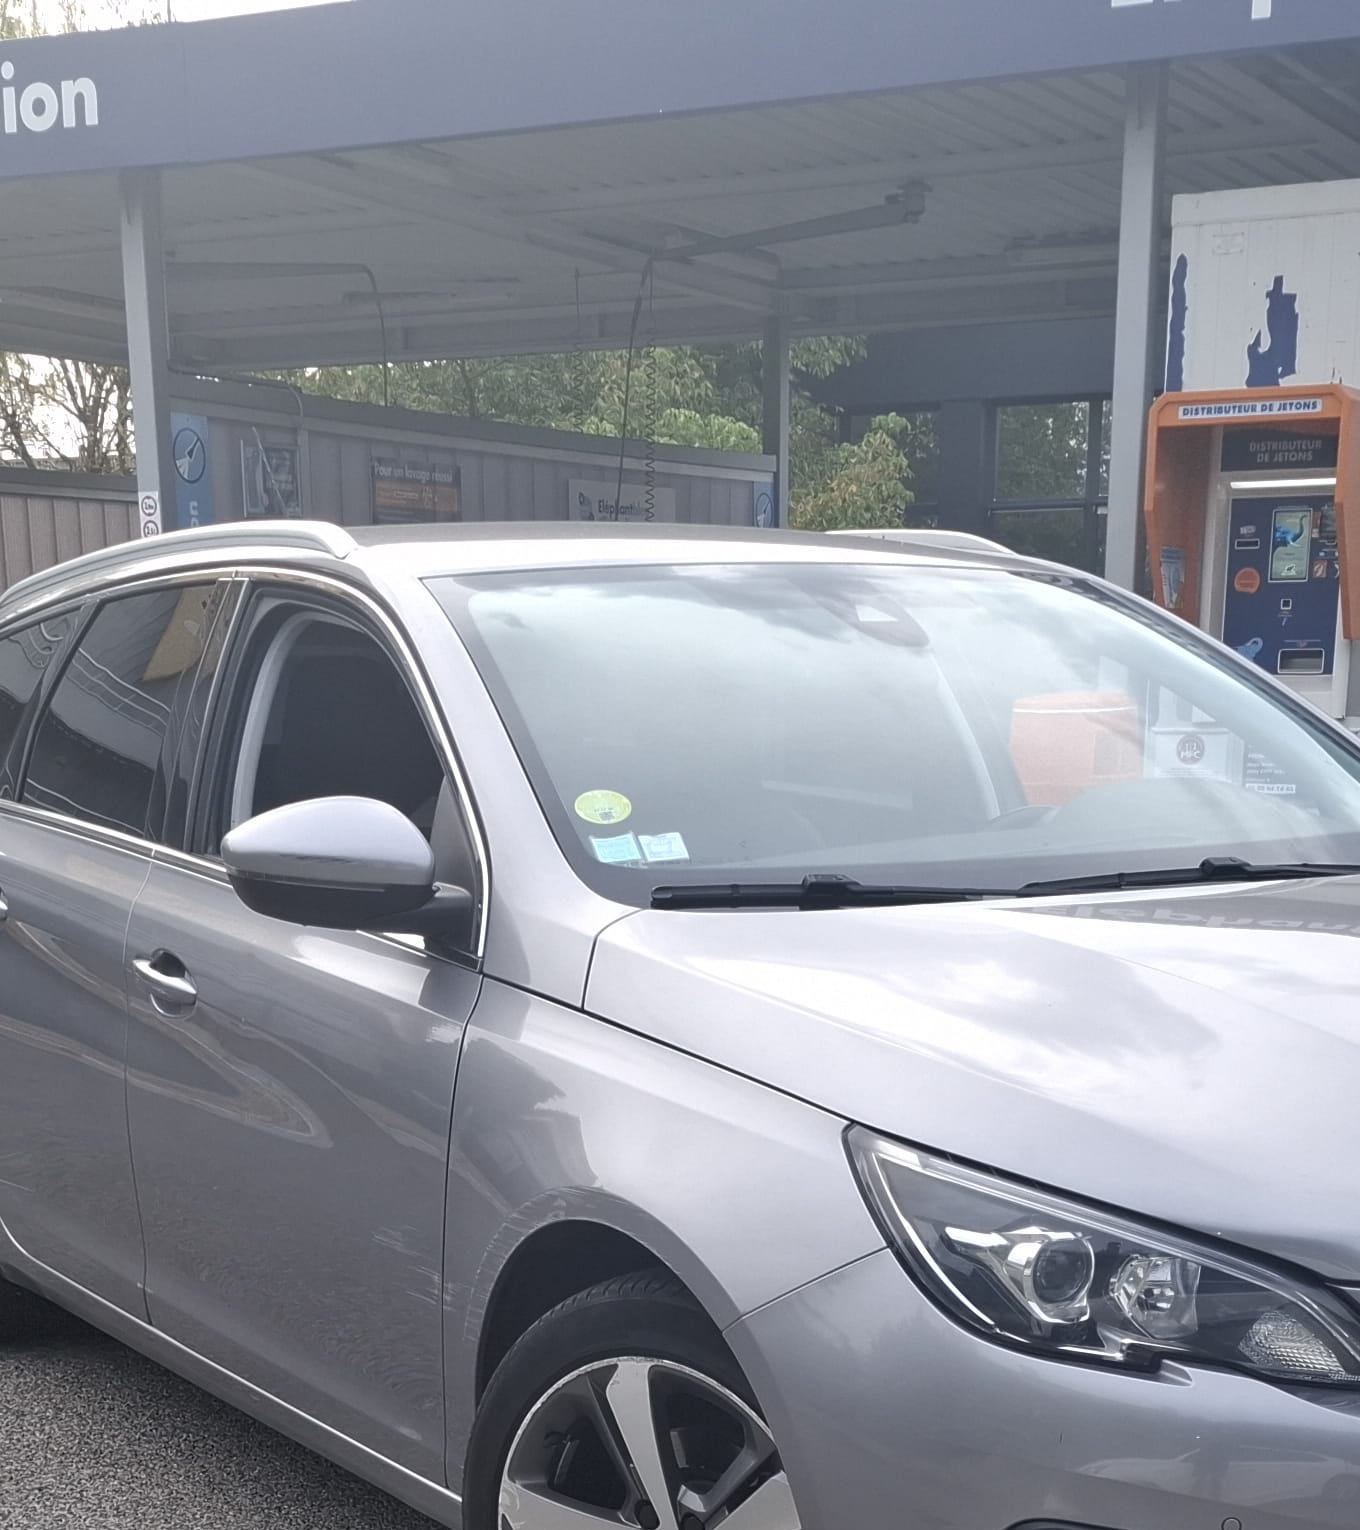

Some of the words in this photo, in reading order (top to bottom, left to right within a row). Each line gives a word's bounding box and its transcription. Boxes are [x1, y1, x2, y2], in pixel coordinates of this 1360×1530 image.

[1182, 404, 1257, 416] DISTRIBUTEUR
[1261, 403, 1273, 413] DE
[1277, 400, 1318, 411] JETONS
[1249, 439, 1322, 452] DISTRIBUTEUR
[1256, 452, 1270, 463] DE
[1272, 451, 1313, 462] JETONS
